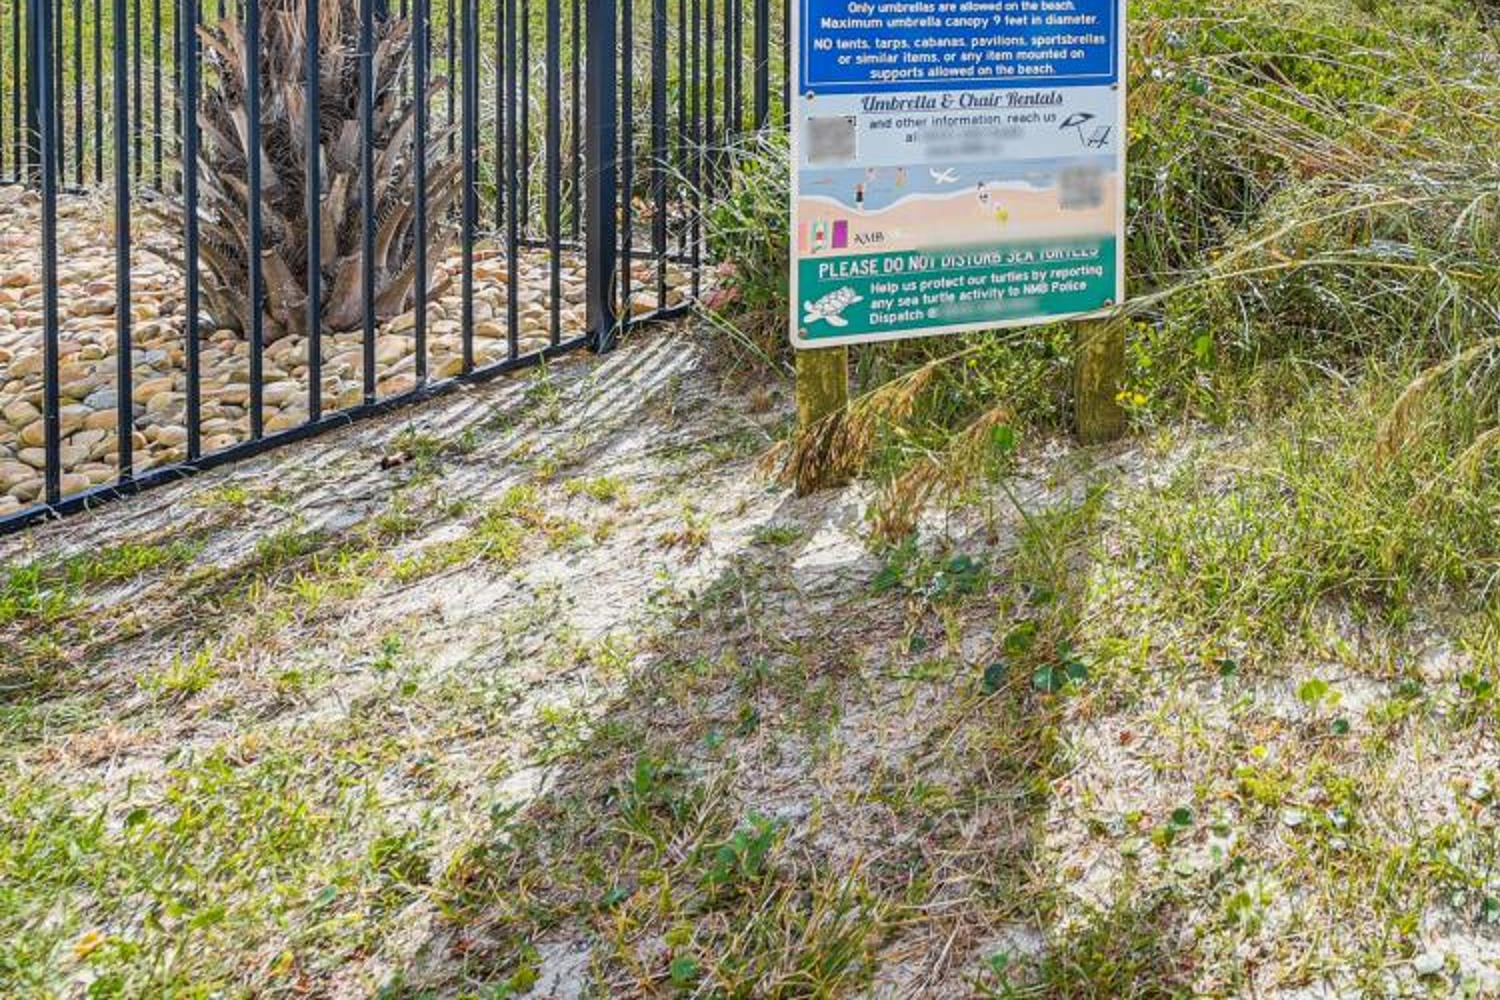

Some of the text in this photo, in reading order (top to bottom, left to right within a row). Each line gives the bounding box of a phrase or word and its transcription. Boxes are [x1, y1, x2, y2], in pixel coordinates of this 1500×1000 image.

[848, 1, 1038, 15] Only umbrellas are allowed the
[821, 14, 1027, 29] Maximum umbrella canopy feet
[814, 38, 832, 50] NO
[856, 49, 1066, 64] similar any item mounted
[870, 66, 1014, 80] supports allowed the
[861, 92, 1062, 110] Umbrella & Chair Rentals
[870, 113, 1056, 128] and other information reach us
[820, 256, 935, 278] PLEASE DO NOT
[870, 266, 1102, 295] Help us protect our turtles by reporting
[871, 281, 1087, 310] any sea turtle activity to NMB Police
[870, 310, 924, 324] Dispatch
